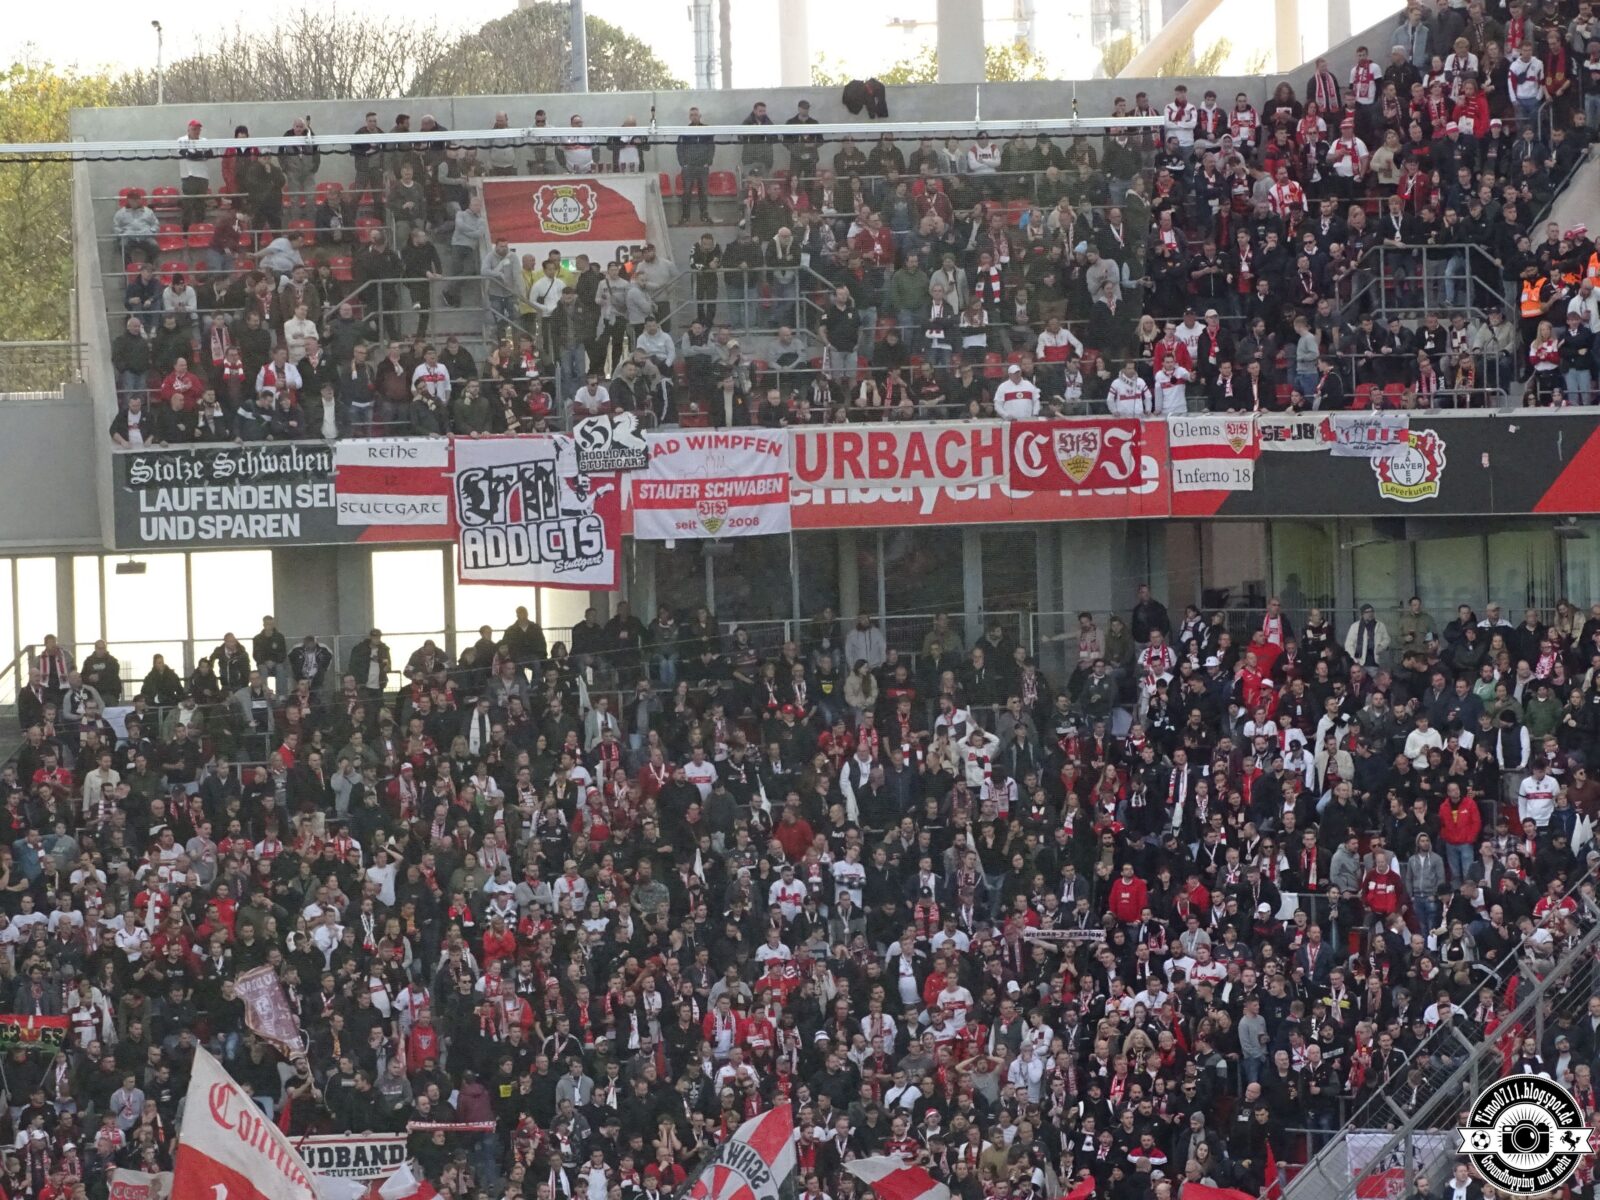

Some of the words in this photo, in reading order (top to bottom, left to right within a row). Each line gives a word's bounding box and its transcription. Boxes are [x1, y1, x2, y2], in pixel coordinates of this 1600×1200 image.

[1172, 422, 1221, 438] Glems
[580, 449, 642, 461] HOOLIGANS
[648, 439, 681, 460] AD
[685, 434, 783, 458] WIMPFEN
[795, 427, 1005, 483] URBACH
[130, 457, 204, 485] Stolze
[212, 445, 331, 479] Schwaben
[579, 457, 646, 471] STUTTGART
[1176, 467, 1230, 484] Inferno
[139, 484, 293, 512] LAUFENDEN
[295, 483, 336, 507] SEI
[639, 483, 700, 500] STAUFER
[704, 477, 784, 498] SCHWABEN
[1385, 484, 1433, 496] Leverkusen
[139, 515, 195, 541] UND
[198, 513, 300, 539] SPAREN
[675, 520, 698, 530] seit
[462, 515, 605, 569] ADDICTS
[553, 553, 604, 574] Stuttgart
[300, 1144, 408, 1169] ÜDBAND
[324, 1167, 382, 1178] STUTTGART
